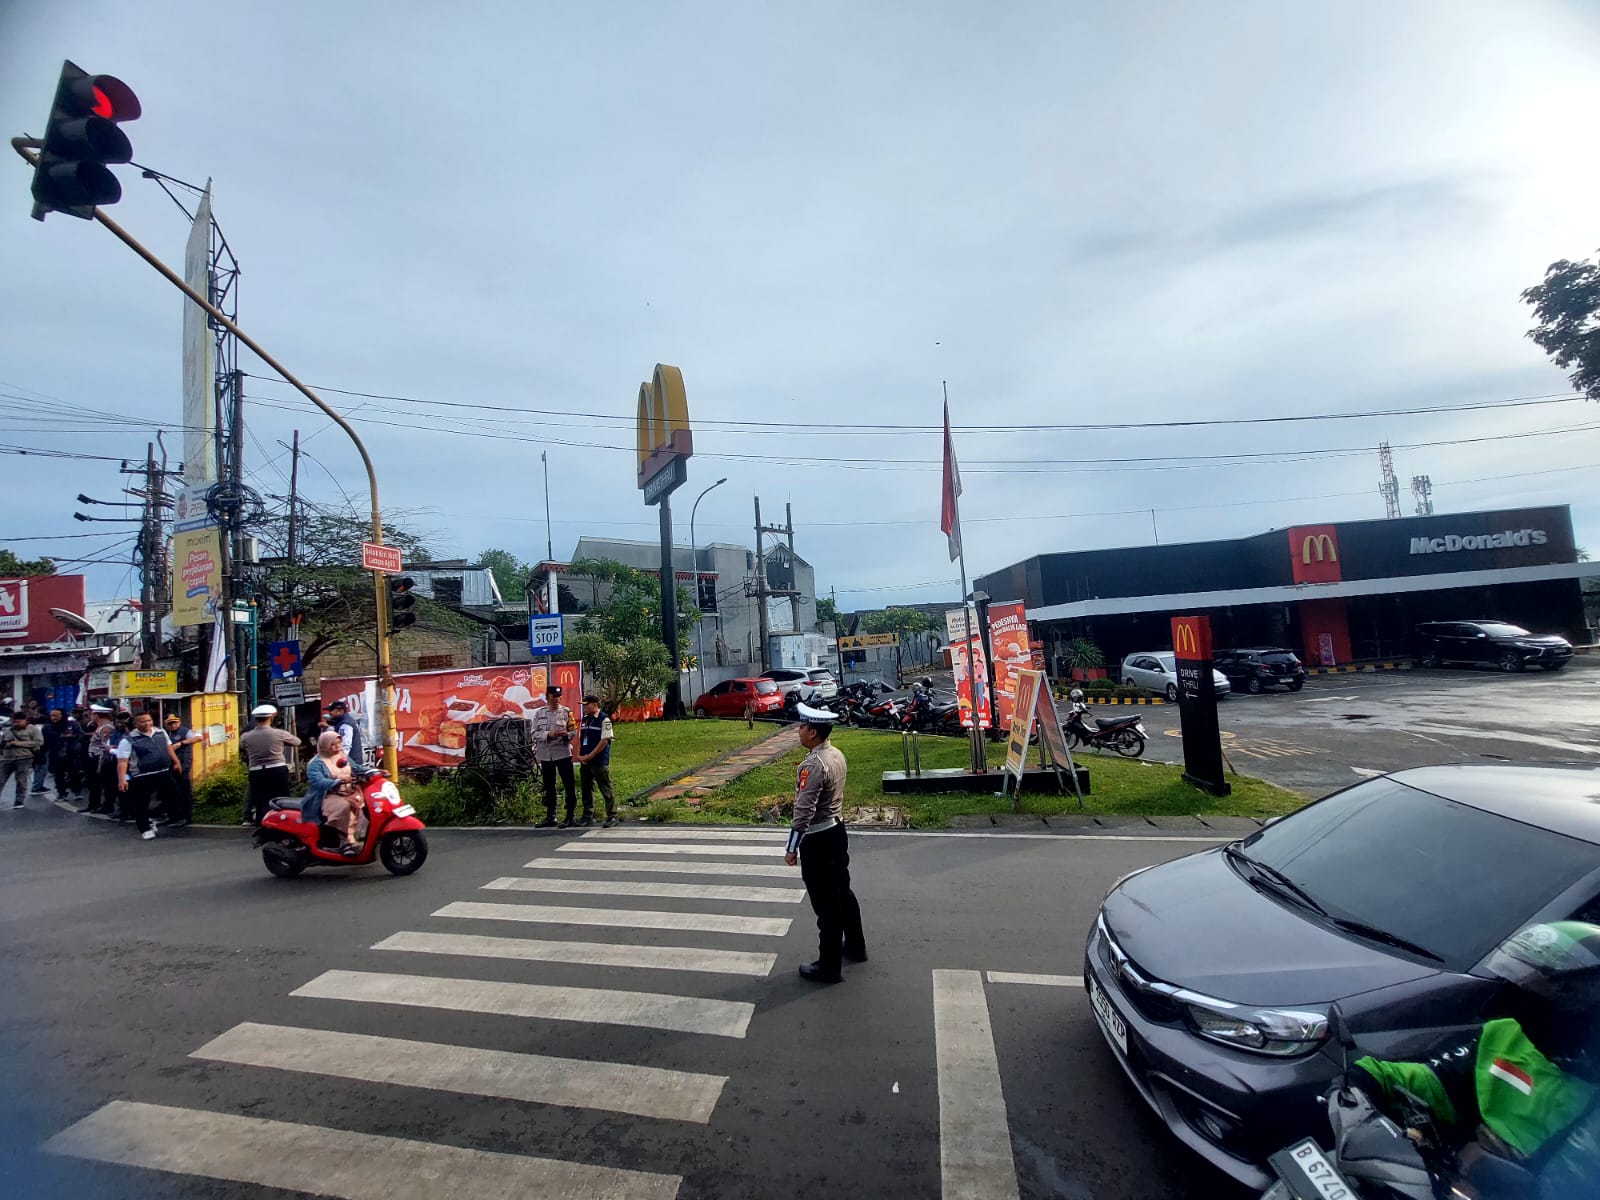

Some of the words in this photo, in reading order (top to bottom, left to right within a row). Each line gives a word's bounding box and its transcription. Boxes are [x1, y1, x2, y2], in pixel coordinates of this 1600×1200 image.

[1409, 528, 1548, 555] McDonald's
[535, 632, 559, 644] STOP
[1180, 668, 1199, 679] DRIVE
[1182, 679, 1199, 690] THRU
[1296, 1146, 1313, 1159] B
[1309, 1161, 1346, 1200] 6740
